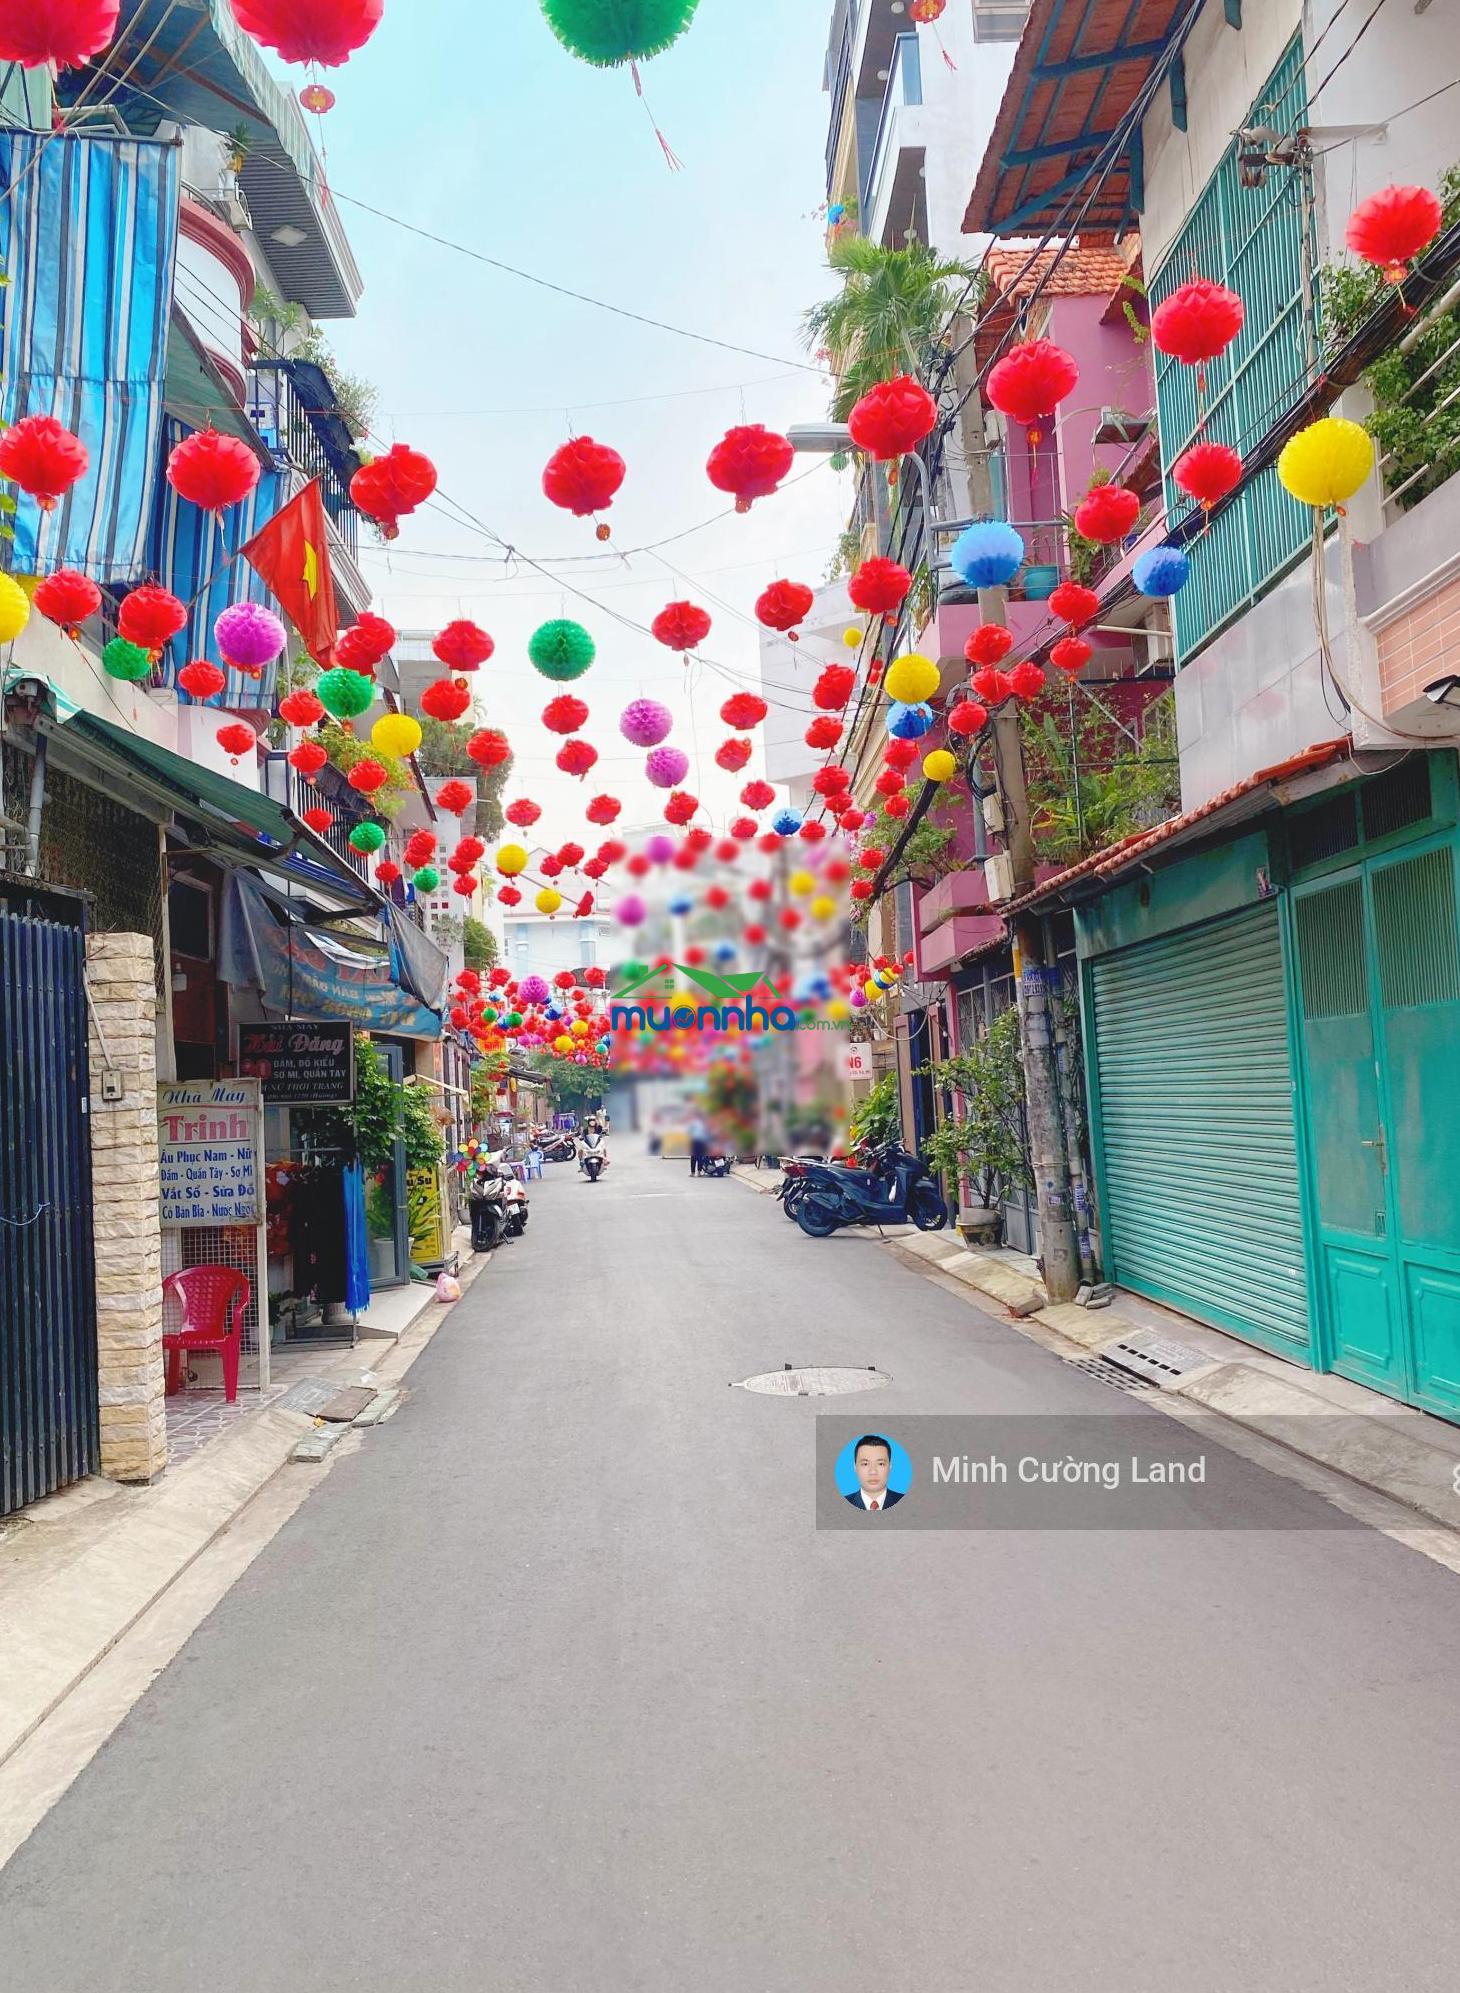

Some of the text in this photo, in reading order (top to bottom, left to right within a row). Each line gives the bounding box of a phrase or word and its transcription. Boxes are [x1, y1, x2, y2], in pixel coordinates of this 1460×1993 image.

[163, 1089, 201, 1104] Nhà
[210, 1087, 246, 1104] May
[176, 1150, 201, 1165] Phục
[203, 1149, 227, 1162] Nam
[237, 1147, 253, 1160] Nữ
[230, 1165, 241, 1178] Sơ
[186, 1184, 201, 1199] Sổ
[192, 1203, 205, 1218] Bia
